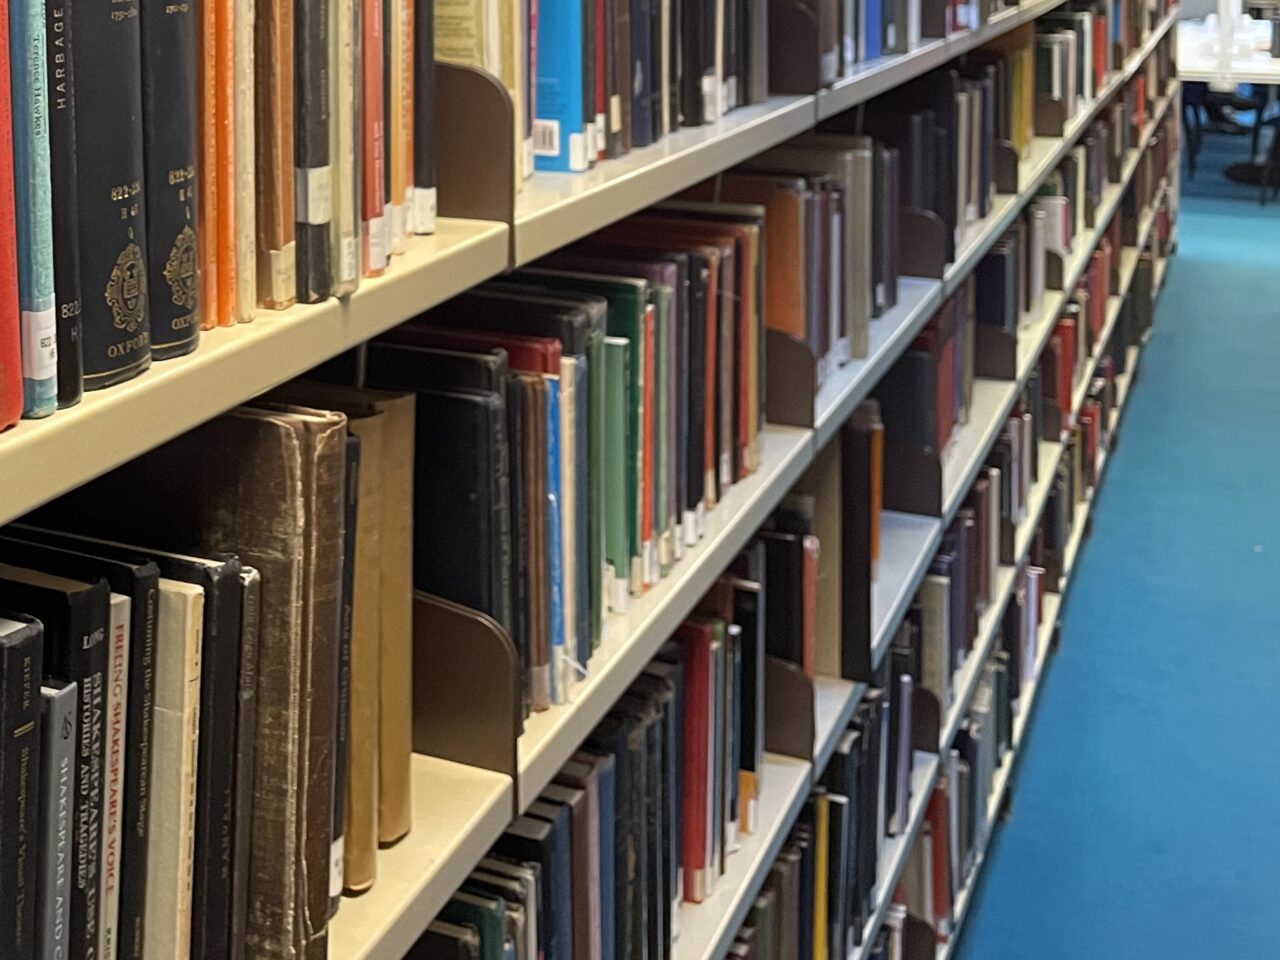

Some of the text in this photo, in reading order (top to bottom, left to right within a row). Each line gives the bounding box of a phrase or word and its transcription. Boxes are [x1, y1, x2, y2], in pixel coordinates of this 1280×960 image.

[53, 7, 66, 110] HARBAGE
[54, 756, 69, 941] SHAKESPEARE AND
[77, 676, 92, 889] HISTORIES AND TRAGEDIES
[88, 671, 104, 879] SHAKESPEARE'S
[105, 623, 126, 894] FREEING SHAKESPEARE'S VOICE
